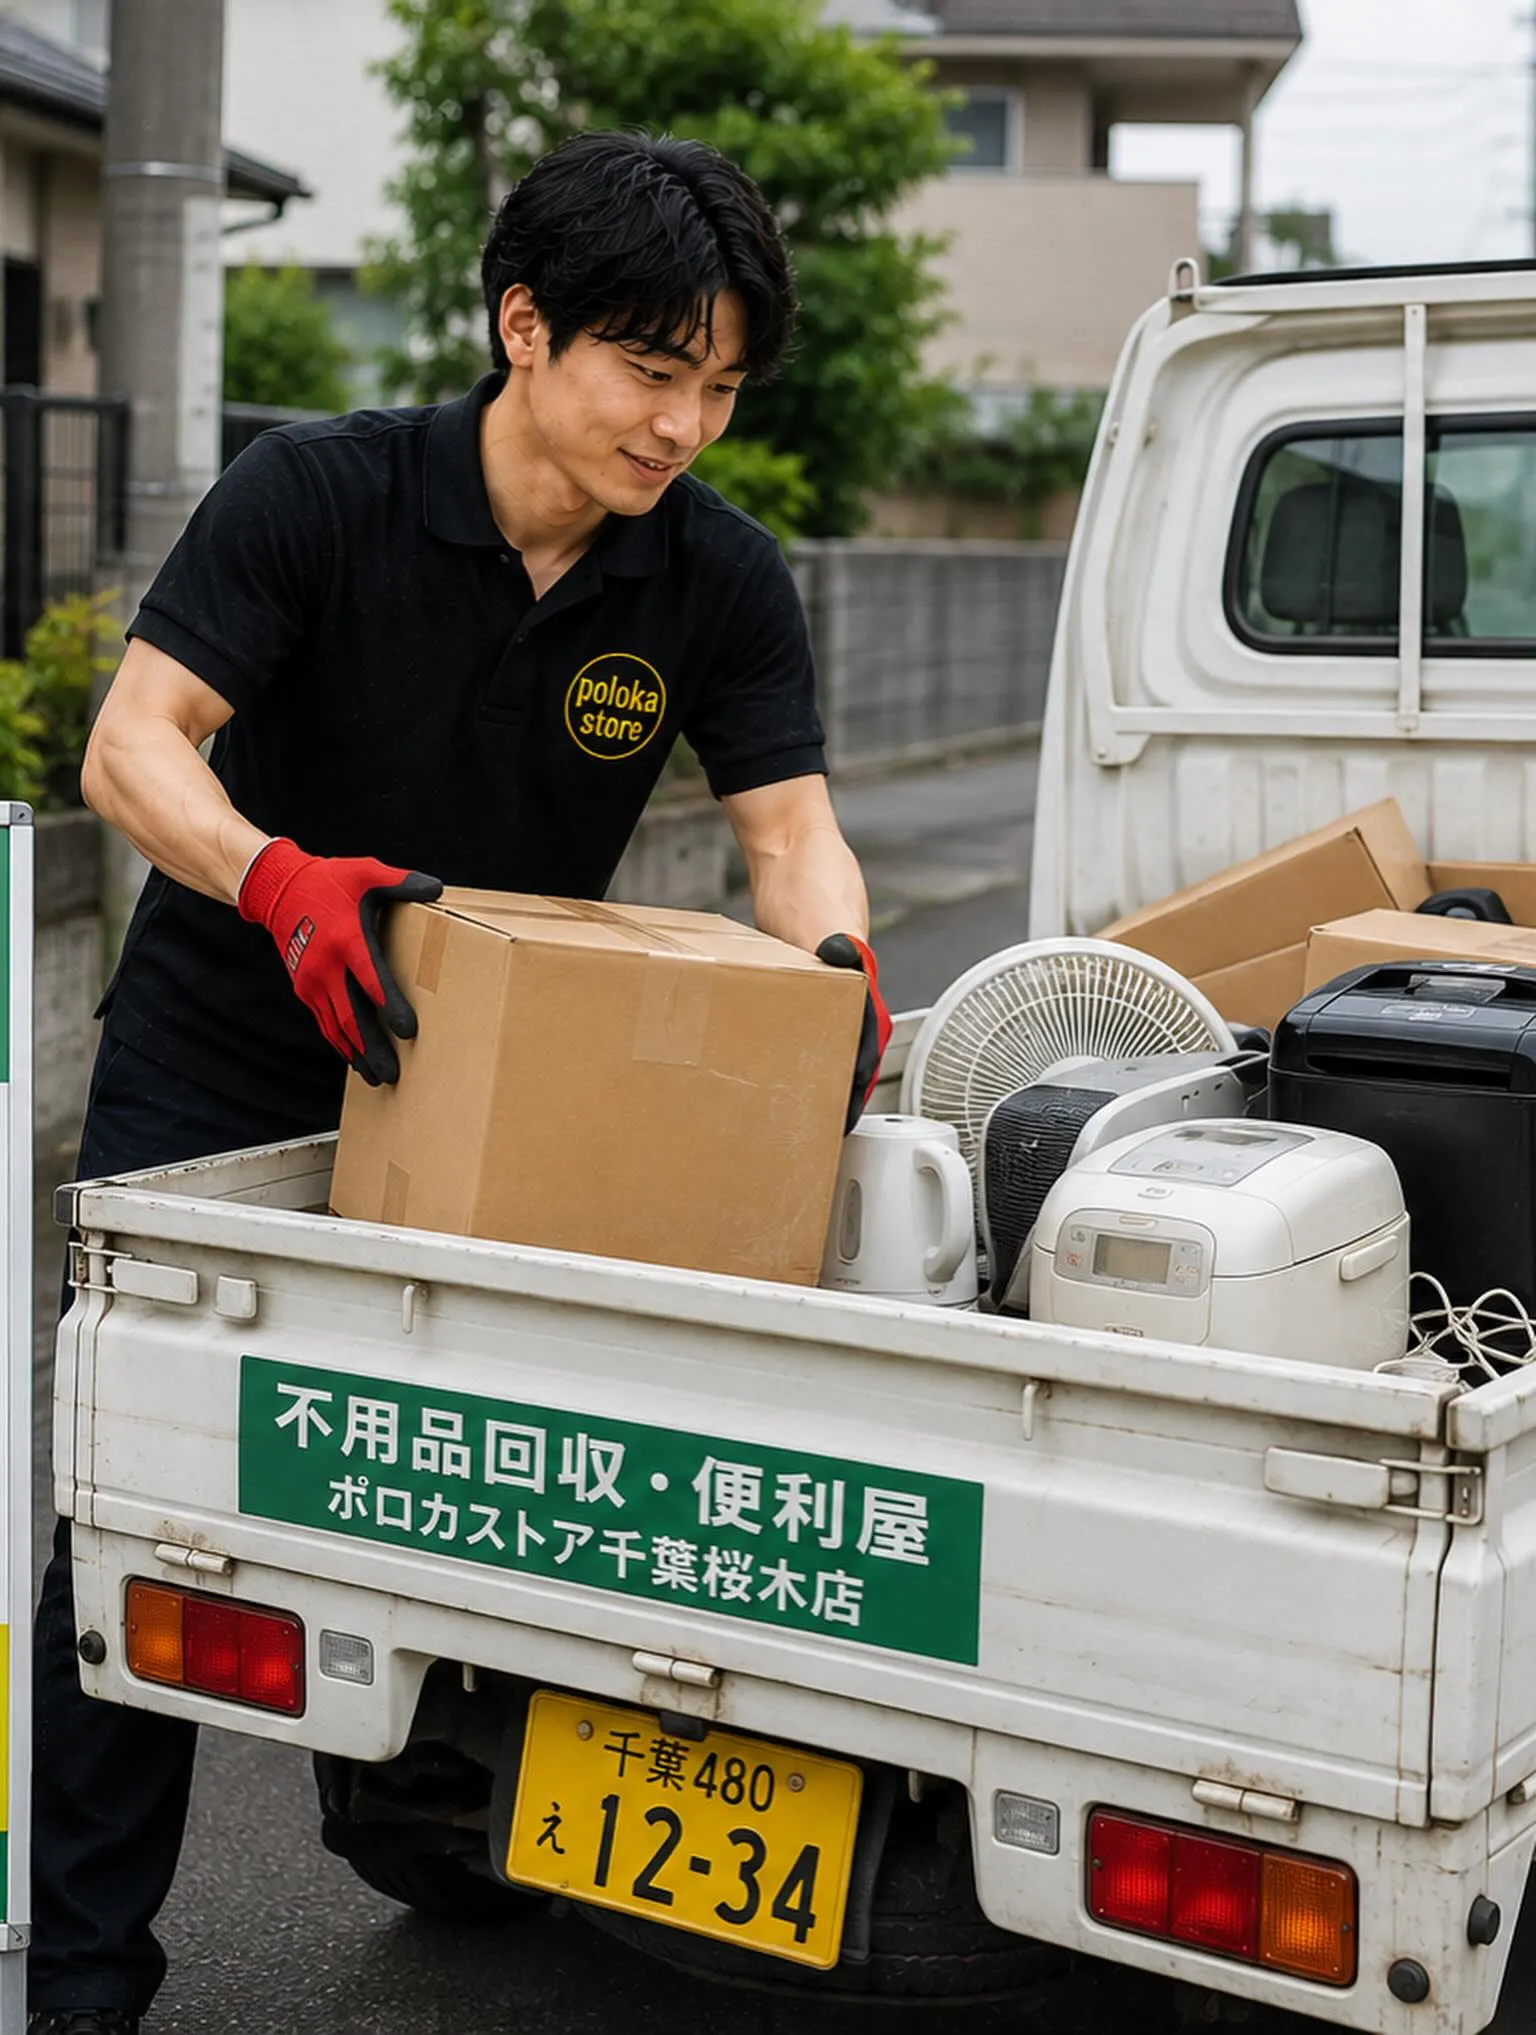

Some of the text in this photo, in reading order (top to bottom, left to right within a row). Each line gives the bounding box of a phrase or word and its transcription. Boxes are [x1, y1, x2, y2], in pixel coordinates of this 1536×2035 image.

[576, 675, 659, 713] poloka
[579, 709, 642, 741] store
[274, 1382, 931, 1567] 不用品回収・便利屋
[327, 1474, 865, 1627] ポロカストア千葉桜木店
[536, 1794, 821, 1944] え 12-34
